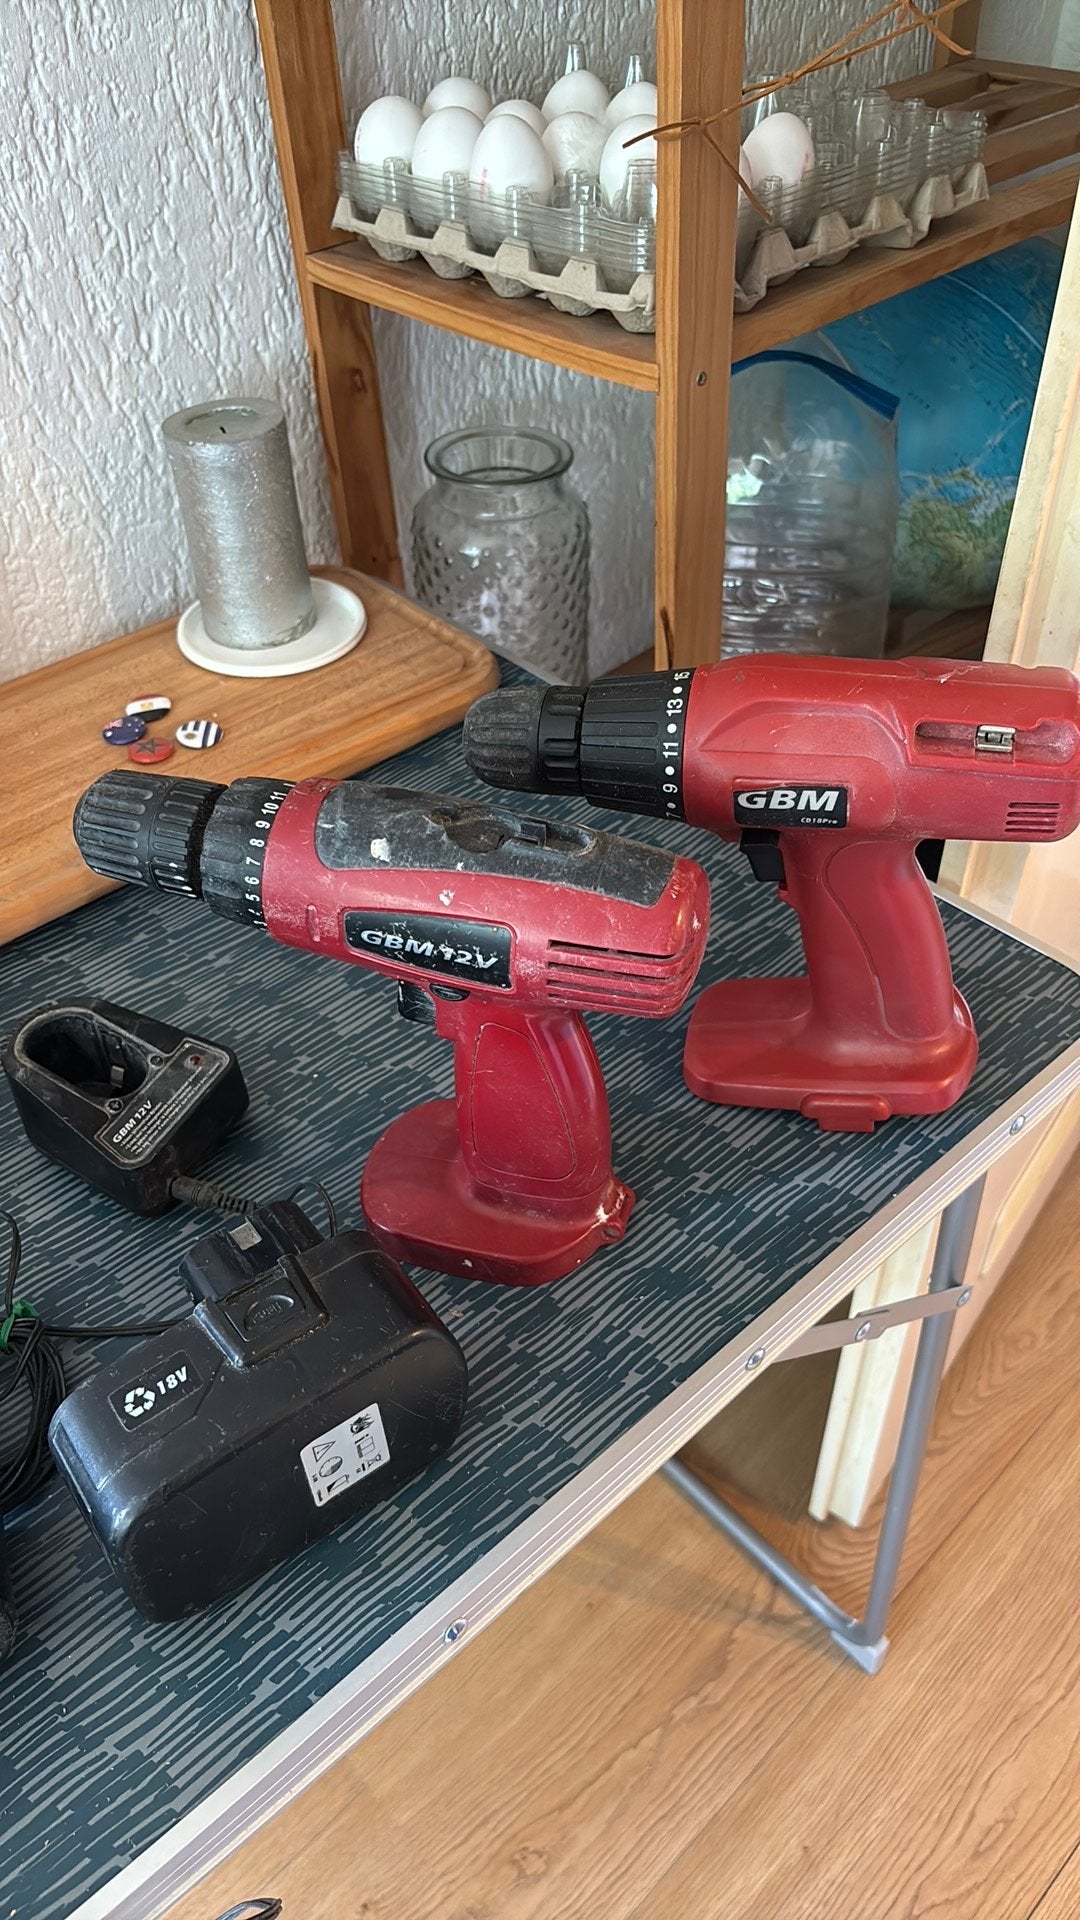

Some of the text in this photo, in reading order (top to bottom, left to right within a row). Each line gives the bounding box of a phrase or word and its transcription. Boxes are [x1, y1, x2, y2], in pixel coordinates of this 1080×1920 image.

[666, 698, 683, 717] 13
[662, 742, 679, 759] 11
[662, 783, 678, 793] 9
[269, 791, 287, 801] 11
[737, 790, 840, 811] GBM
[261, 802, 279, 815] 10
[255, 820, 271, 830] 9
[249, 838, 265, 848] 8
[245, 857, 261, 866] 7
[244, 876, 260, 885] 6
[245, 893, 260, 902] 5
[360, 930, 499, 969] GBM 12V
[112, 1118, 137, 1143] GBM
[134, 1100, 153, 1120] 12V
[156, 1365, 189, 1395] 18V
